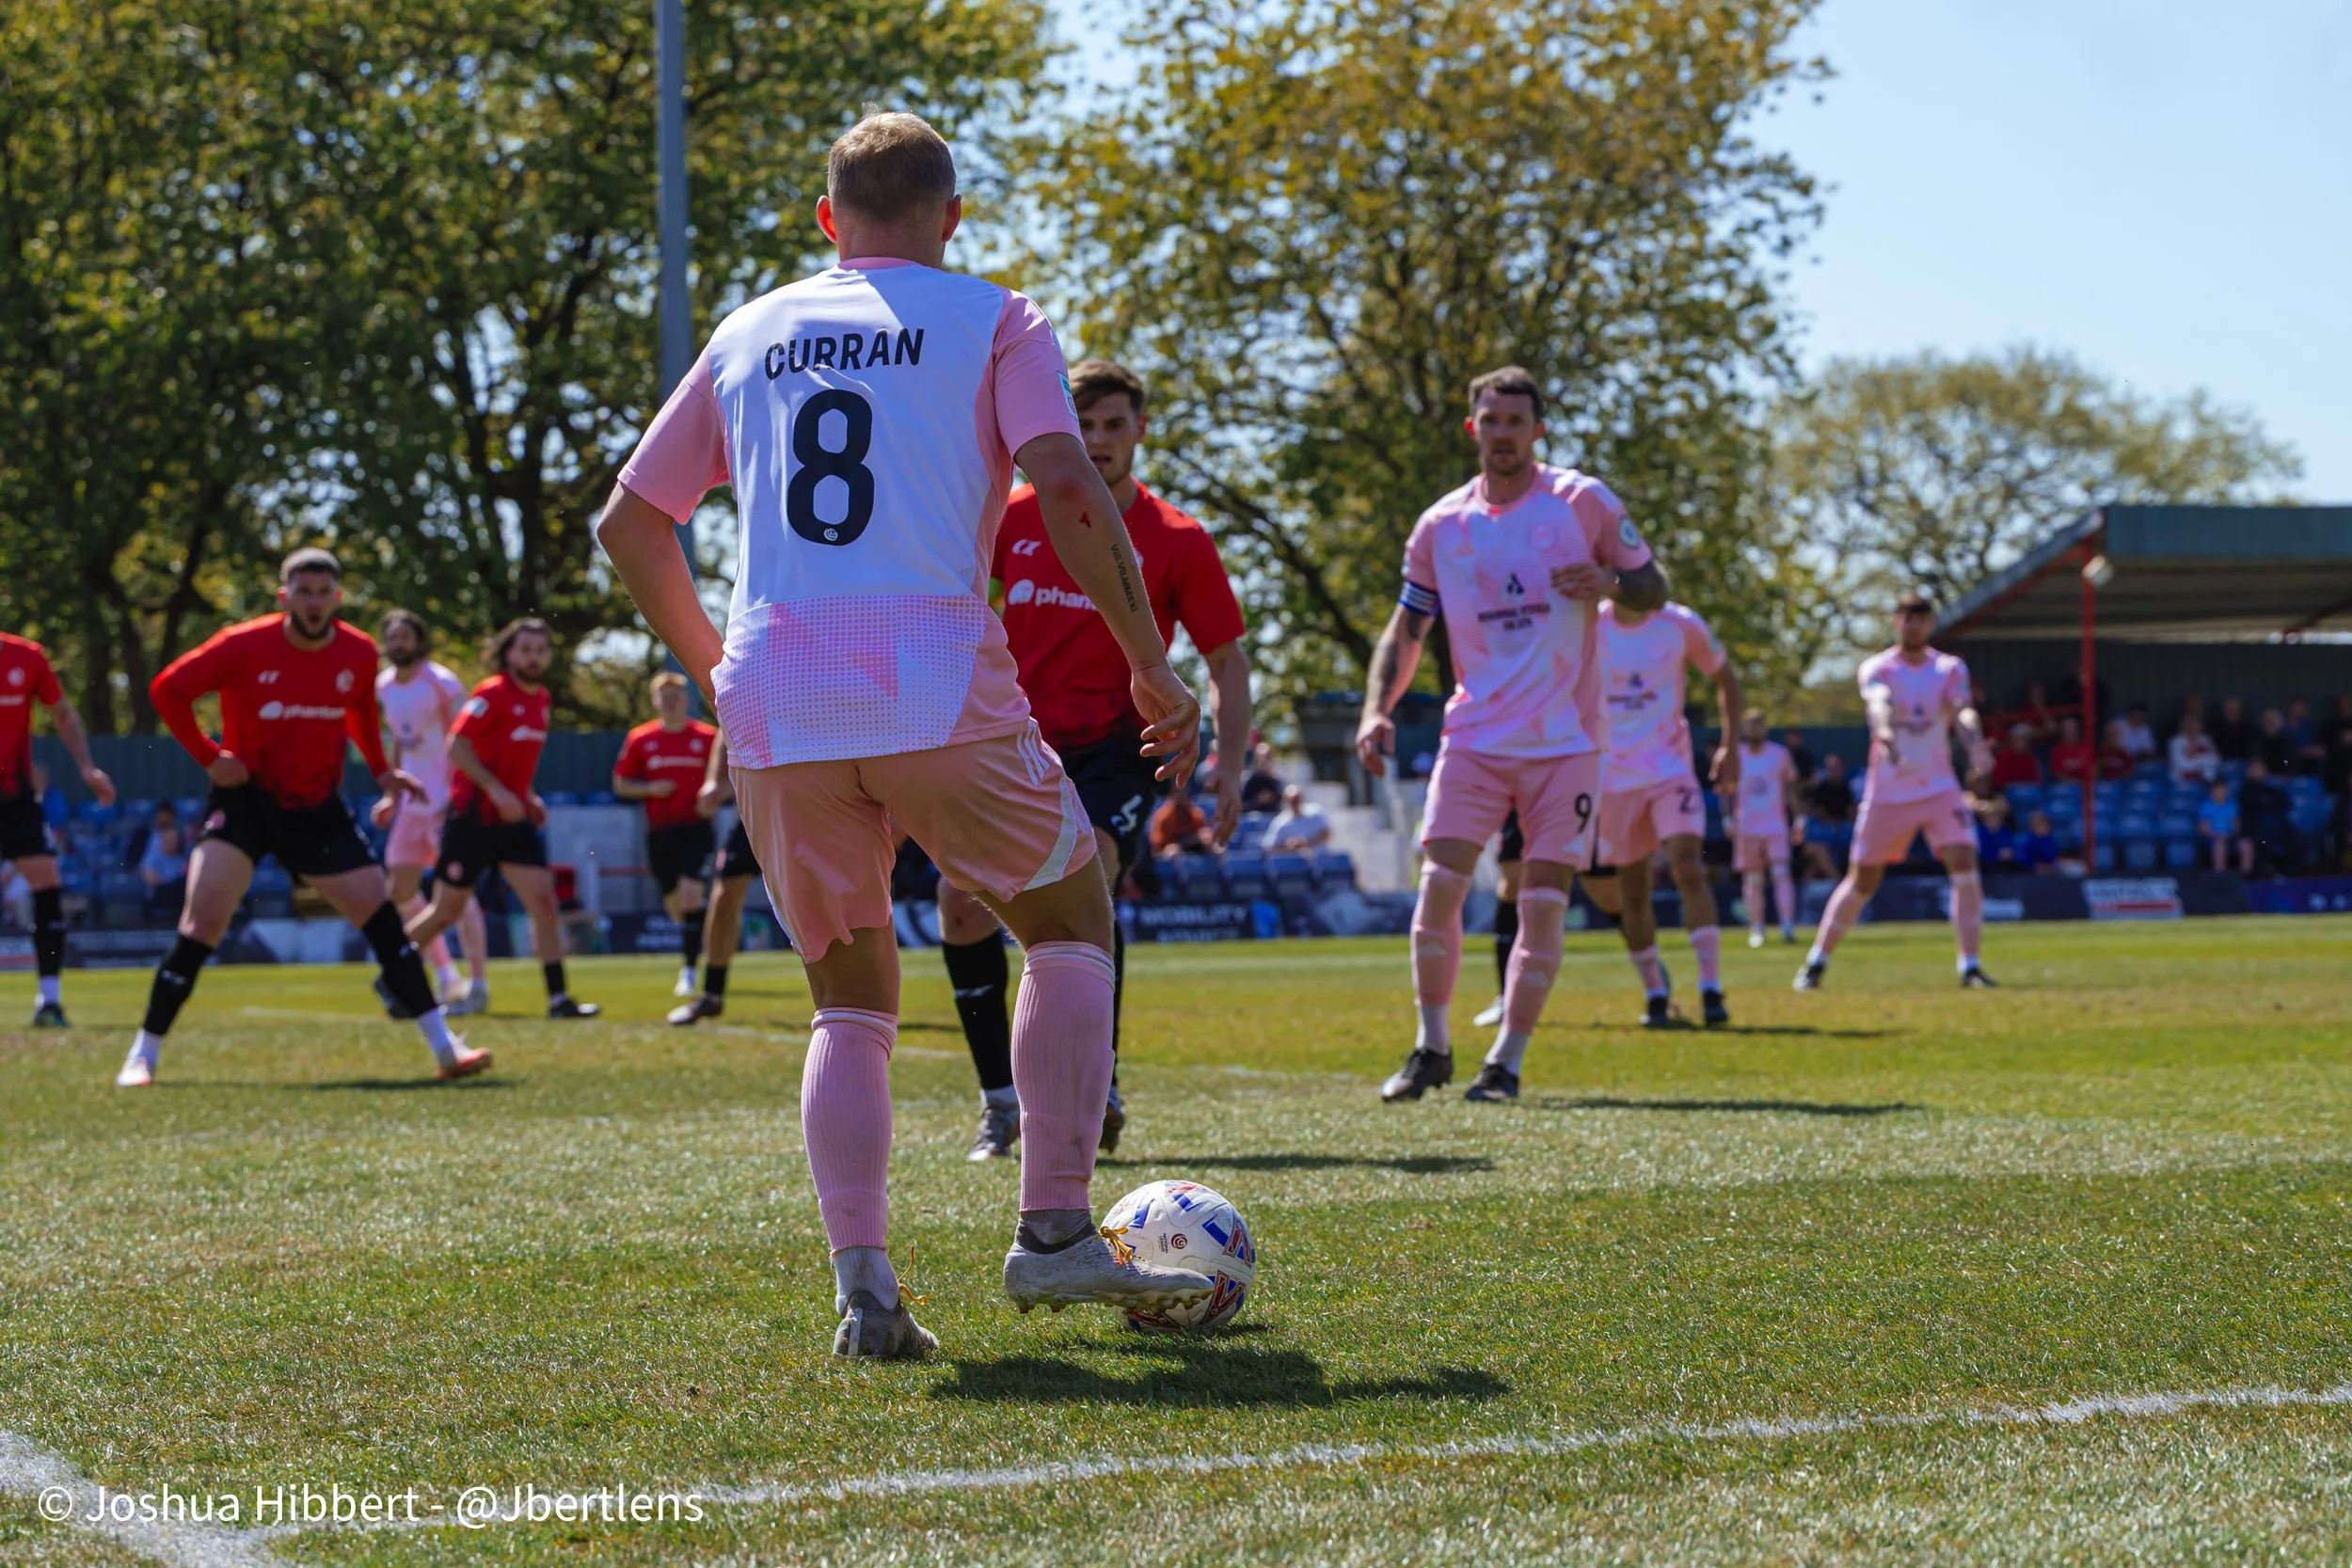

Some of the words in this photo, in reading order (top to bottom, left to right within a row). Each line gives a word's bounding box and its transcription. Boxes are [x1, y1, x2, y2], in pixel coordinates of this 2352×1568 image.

[765, 328, 924, 380] CURRAN
[787, 388, 875, 546] 8
[1036, 585, 1097, 610] phan
[1575, 792, 1592, 834] 9
